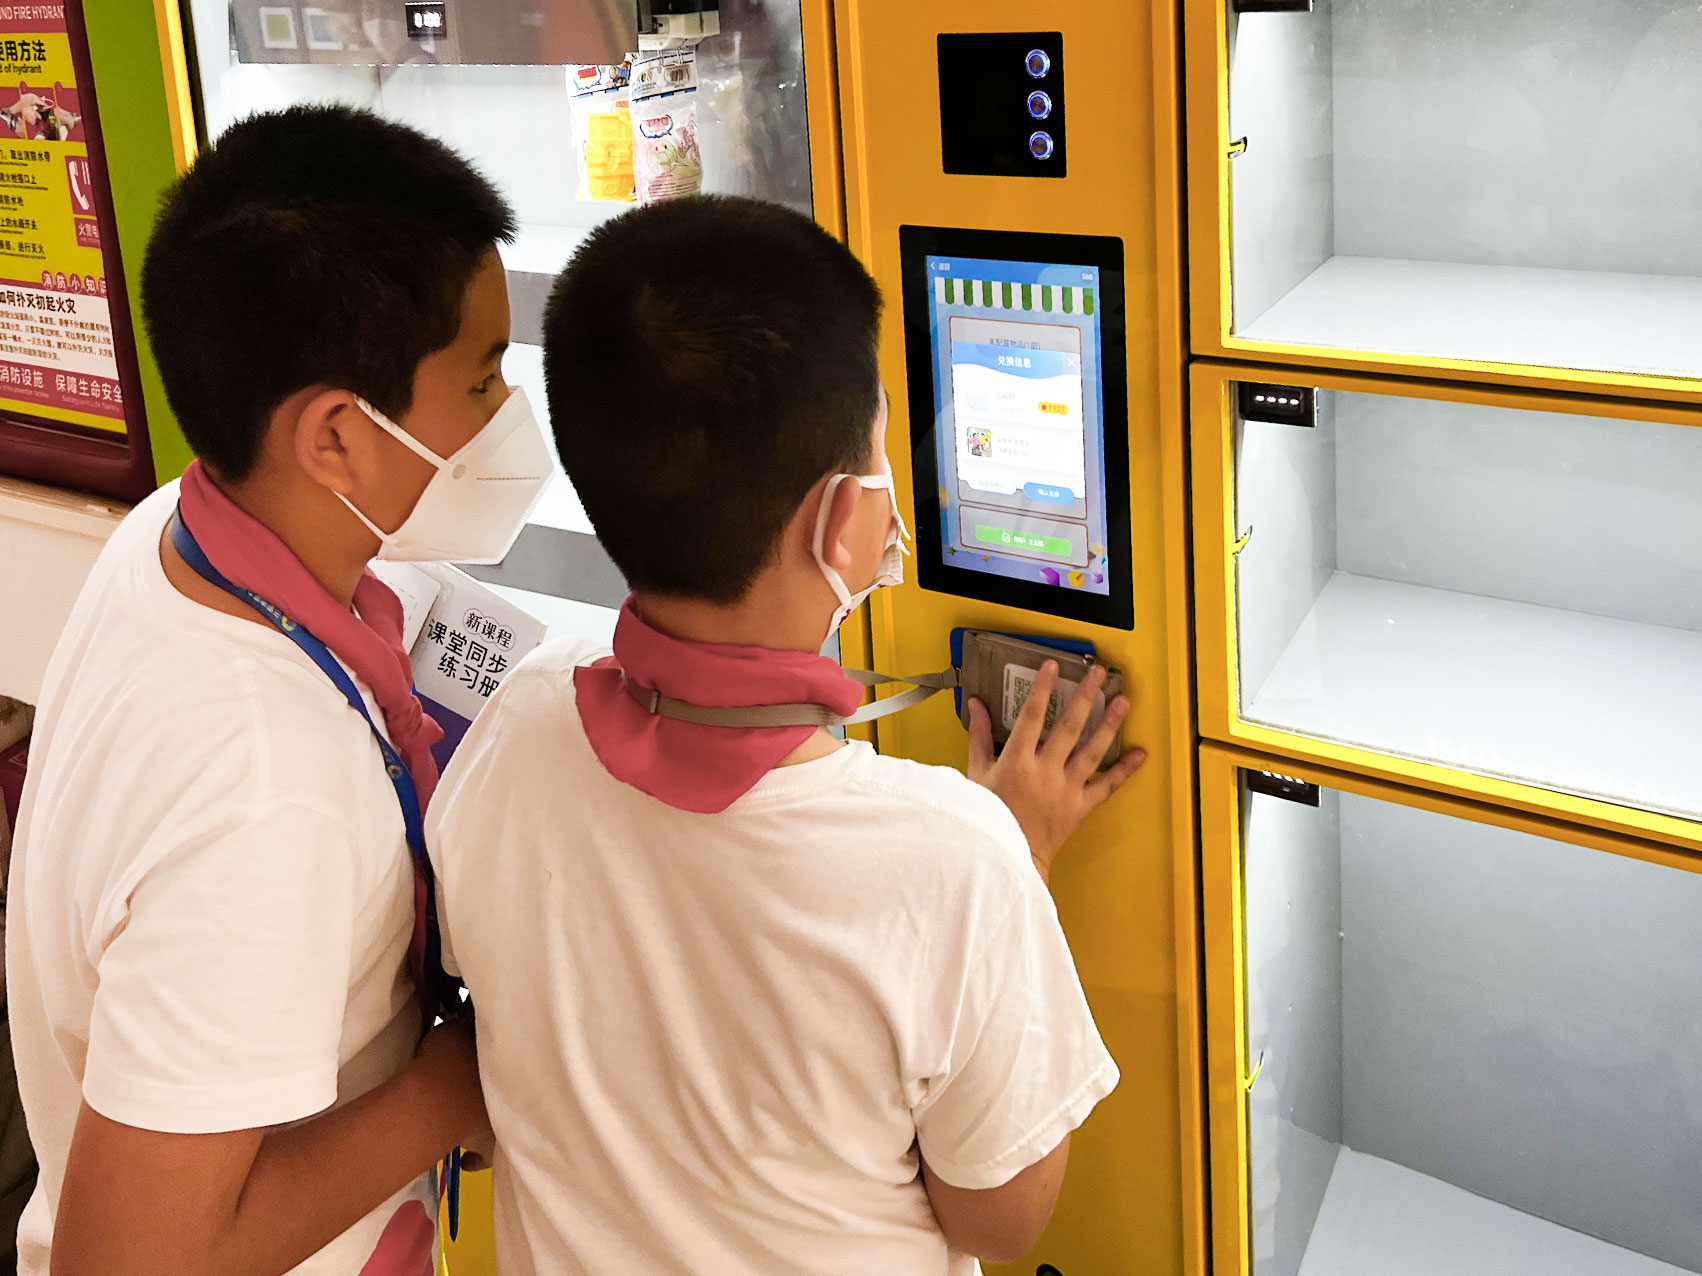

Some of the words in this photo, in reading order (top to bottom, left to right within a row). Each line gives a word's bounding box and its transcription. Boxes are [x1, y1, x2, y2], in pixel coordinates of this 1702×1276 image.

[13, 6, 32, 20] FIRE
[998, 354, 1031, 369] 兑换信息
[55, 373, 123, 404] 保障生命安全
[1048, 404, 1065, 414] 1127
[465, 611, 513, 649] 新课程
[426, 618, 508, 675] 课堂同步
[437, 652, 500, 698] 练习册
